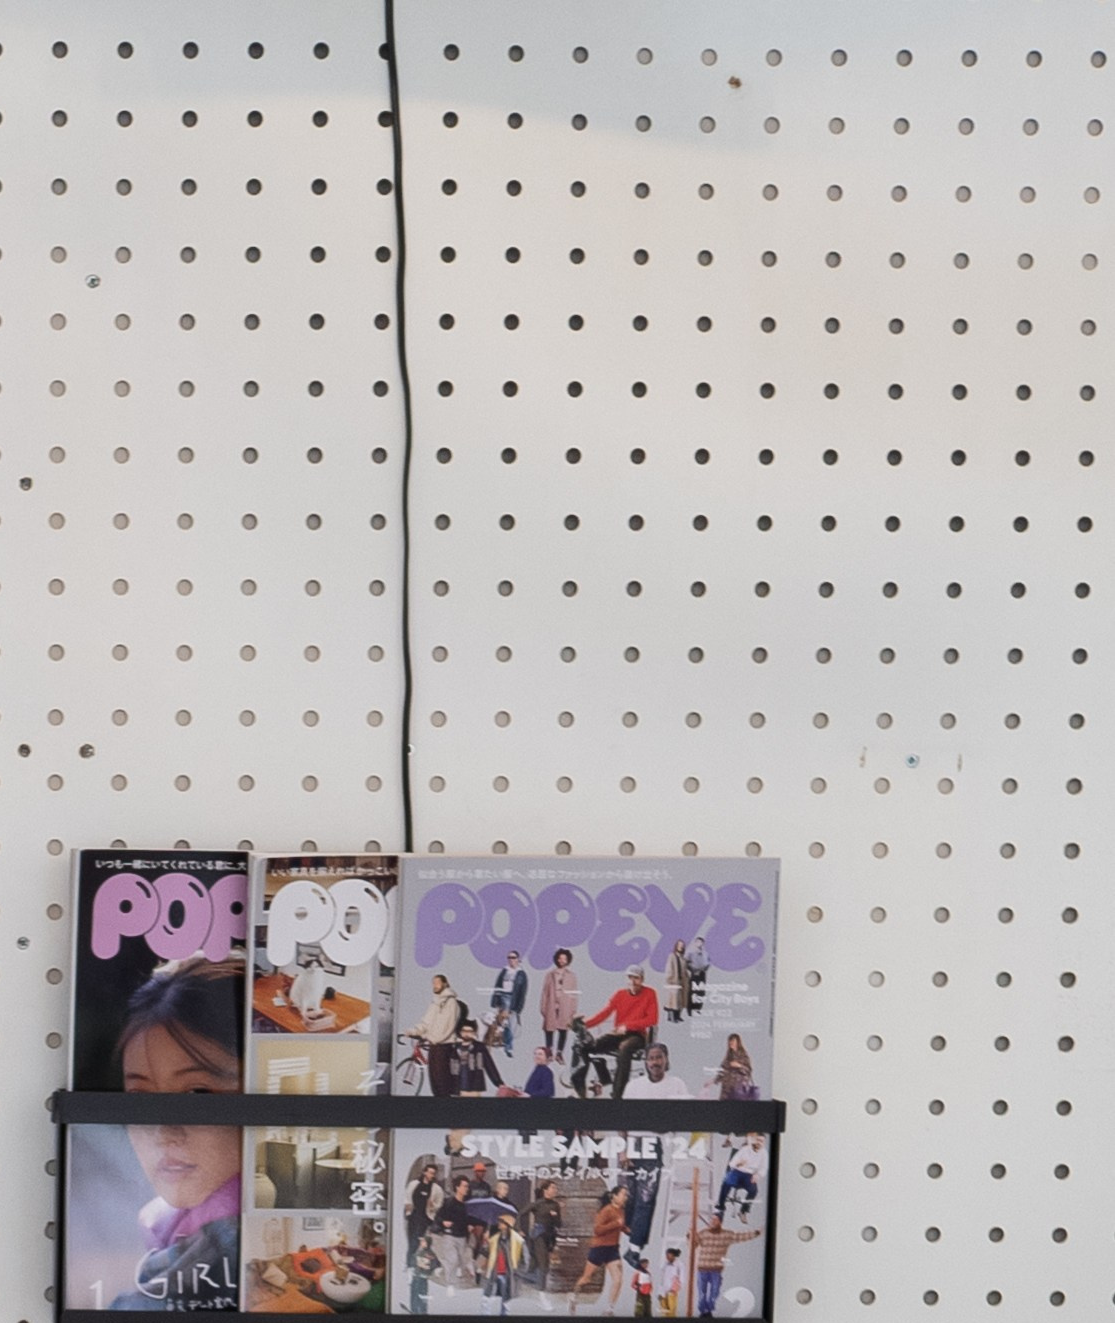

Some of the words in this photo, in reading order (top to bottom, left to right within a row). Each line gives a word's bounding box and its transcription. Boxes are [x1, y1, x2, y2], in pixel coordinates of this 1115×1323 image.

[267, 878, 398, 967] PO
[415, 882, 765, 971] POPEYE
[460, 1134, 545, 1159] STYLE
[551, 1134, 658, 1160] SAMPLE
[136, 1248, 237, 1299] GIRL
